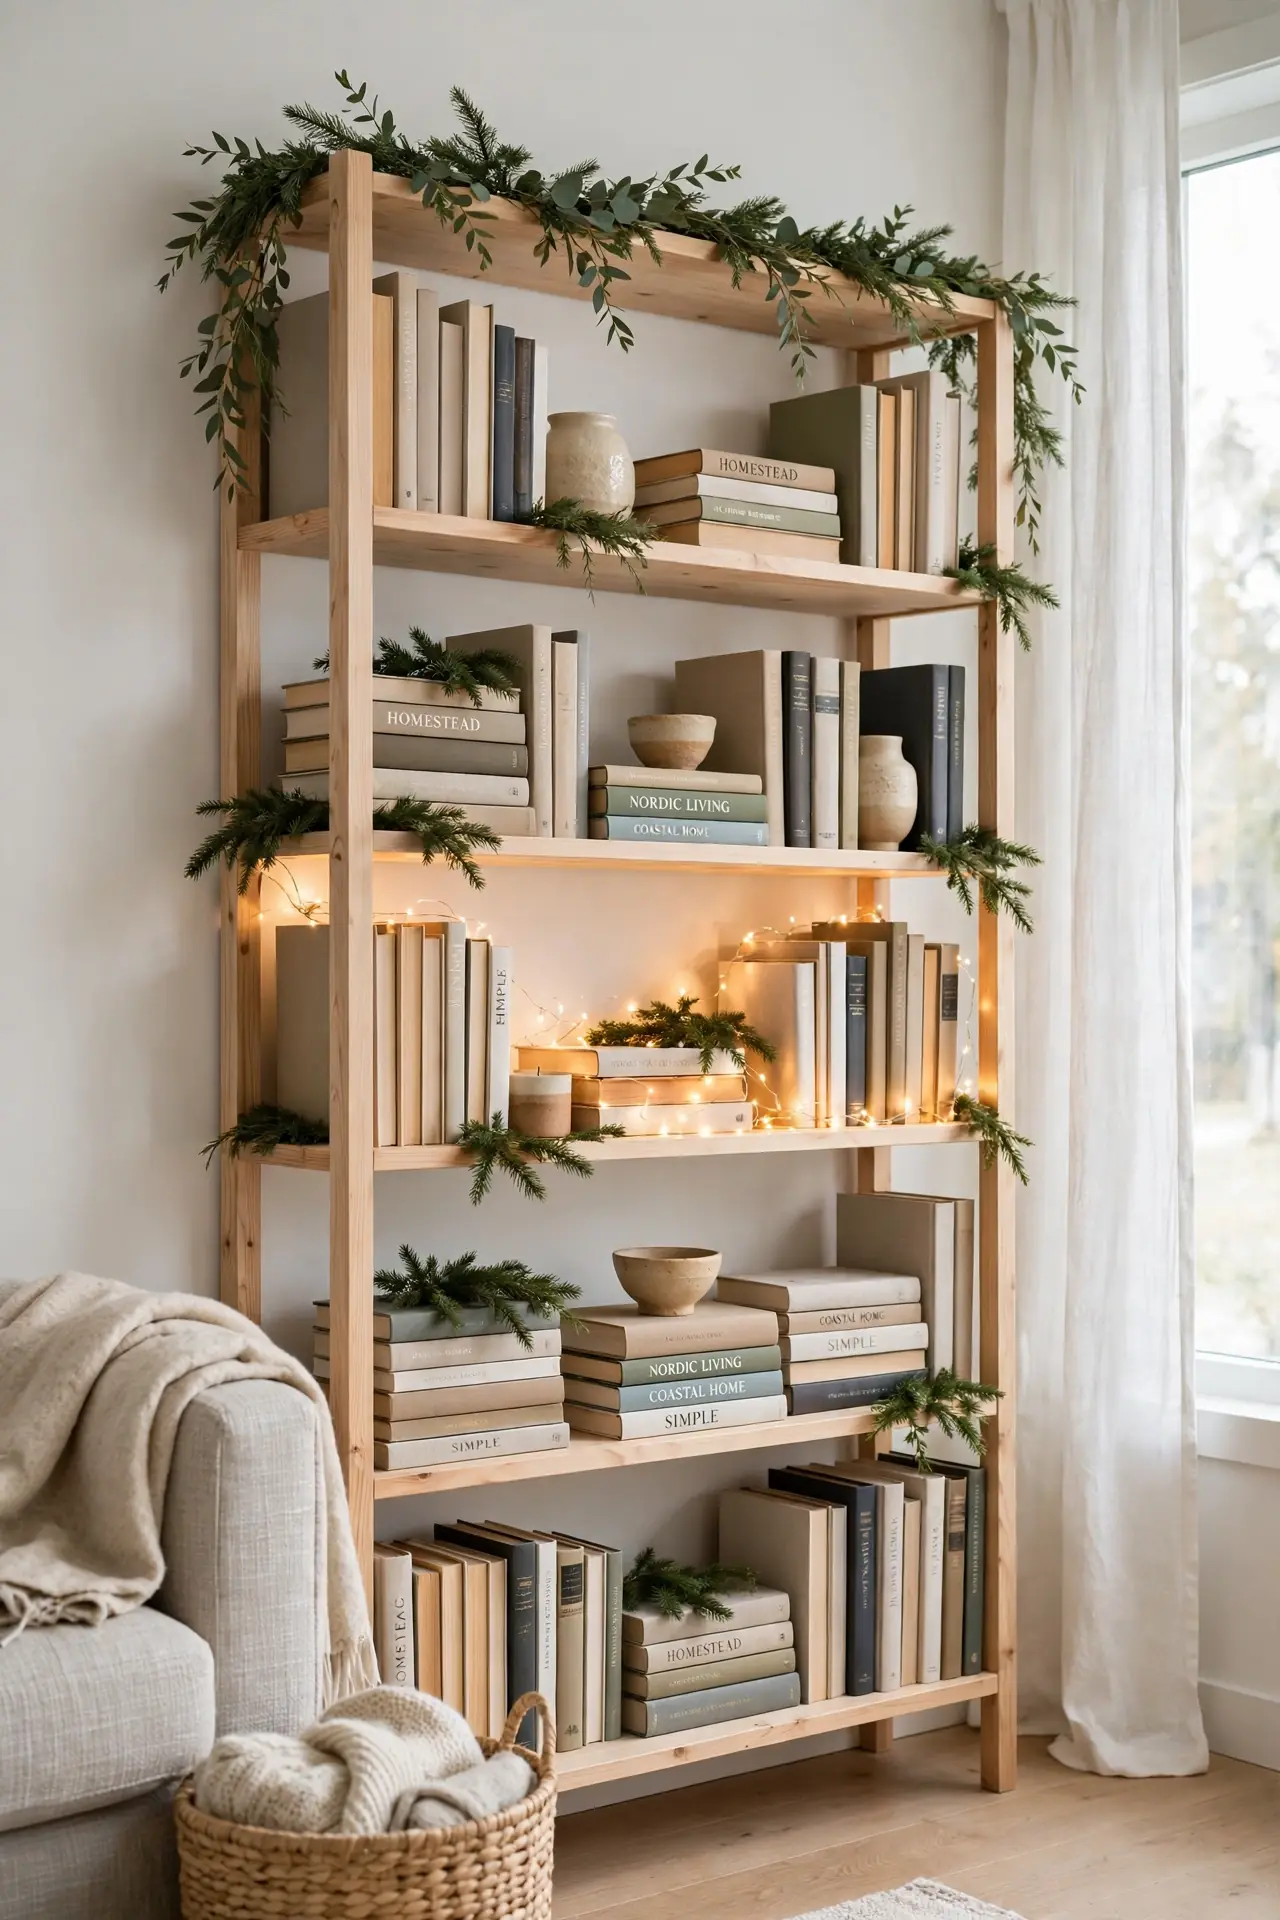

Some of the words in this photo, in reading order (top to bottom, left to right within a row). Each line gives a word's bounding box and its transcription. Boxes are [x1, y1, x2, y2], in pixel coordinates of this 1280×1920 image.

[719, 457, 799, 482] HOMESTEAD
[387, 711, 481, 732] HOMESTEAD
[629, 795, 682, 811] NORDIC
[686, 798, 731, 813] LIVING
[827, 1334, 877, 1352] SIMPLE
[649, 1360, 698, 1378] NORDIC
[701, 1356, 742, 1373] LIVING
[649, 1384, 707, 1403] COASTAL
[709, 1380, 746, 1397] HOME
[665, 1409, 719, 1429] SIMPLE
[451, 1437, 501, 1453] SIMPLE
[667, 1637, 742, 1663] HOMESTEAD
